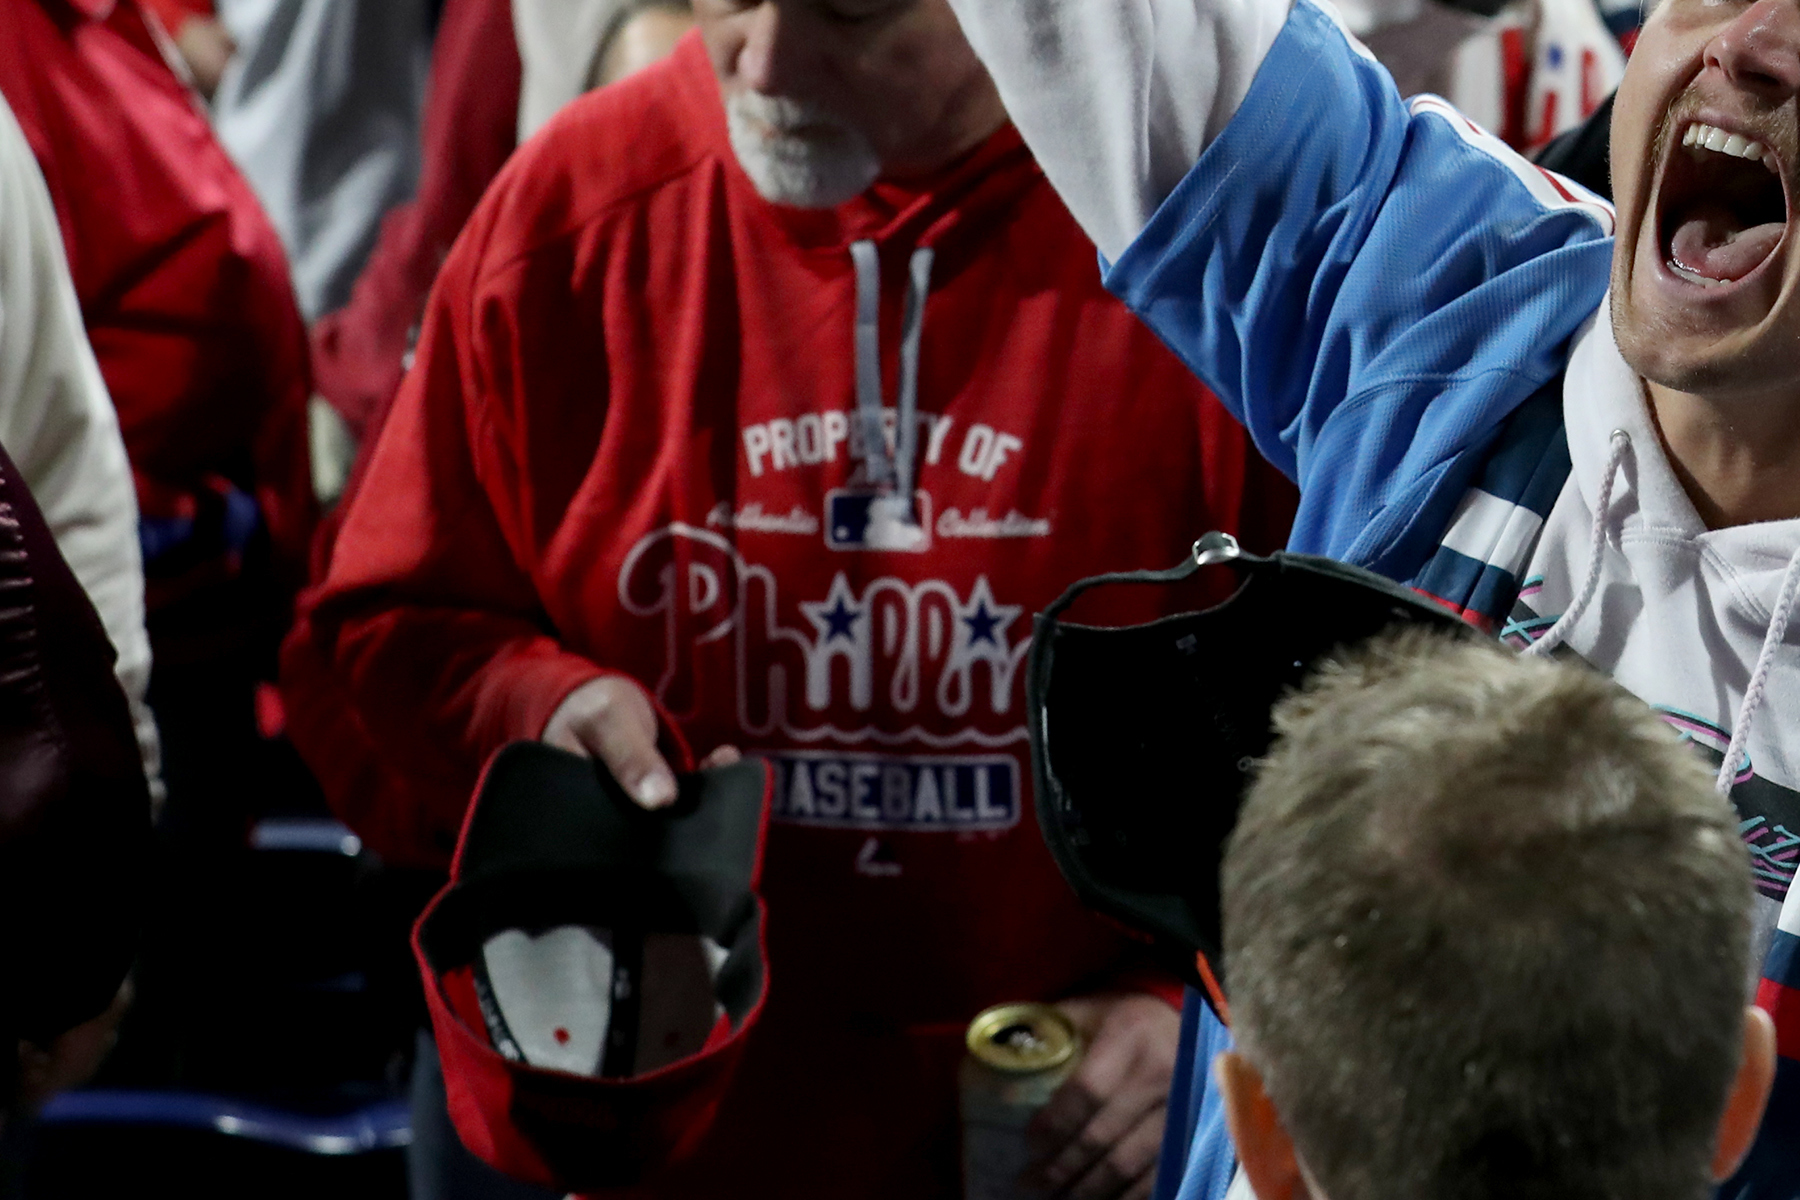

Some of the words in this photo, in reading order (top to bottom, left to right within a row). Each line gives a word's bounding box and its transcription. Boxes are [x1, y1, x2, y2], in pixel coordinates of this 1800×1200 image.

[742, 408, 955, 478] PROPY
[956, 422, 1024, 483] OF
[617, 521, 1034, 738] Philli
